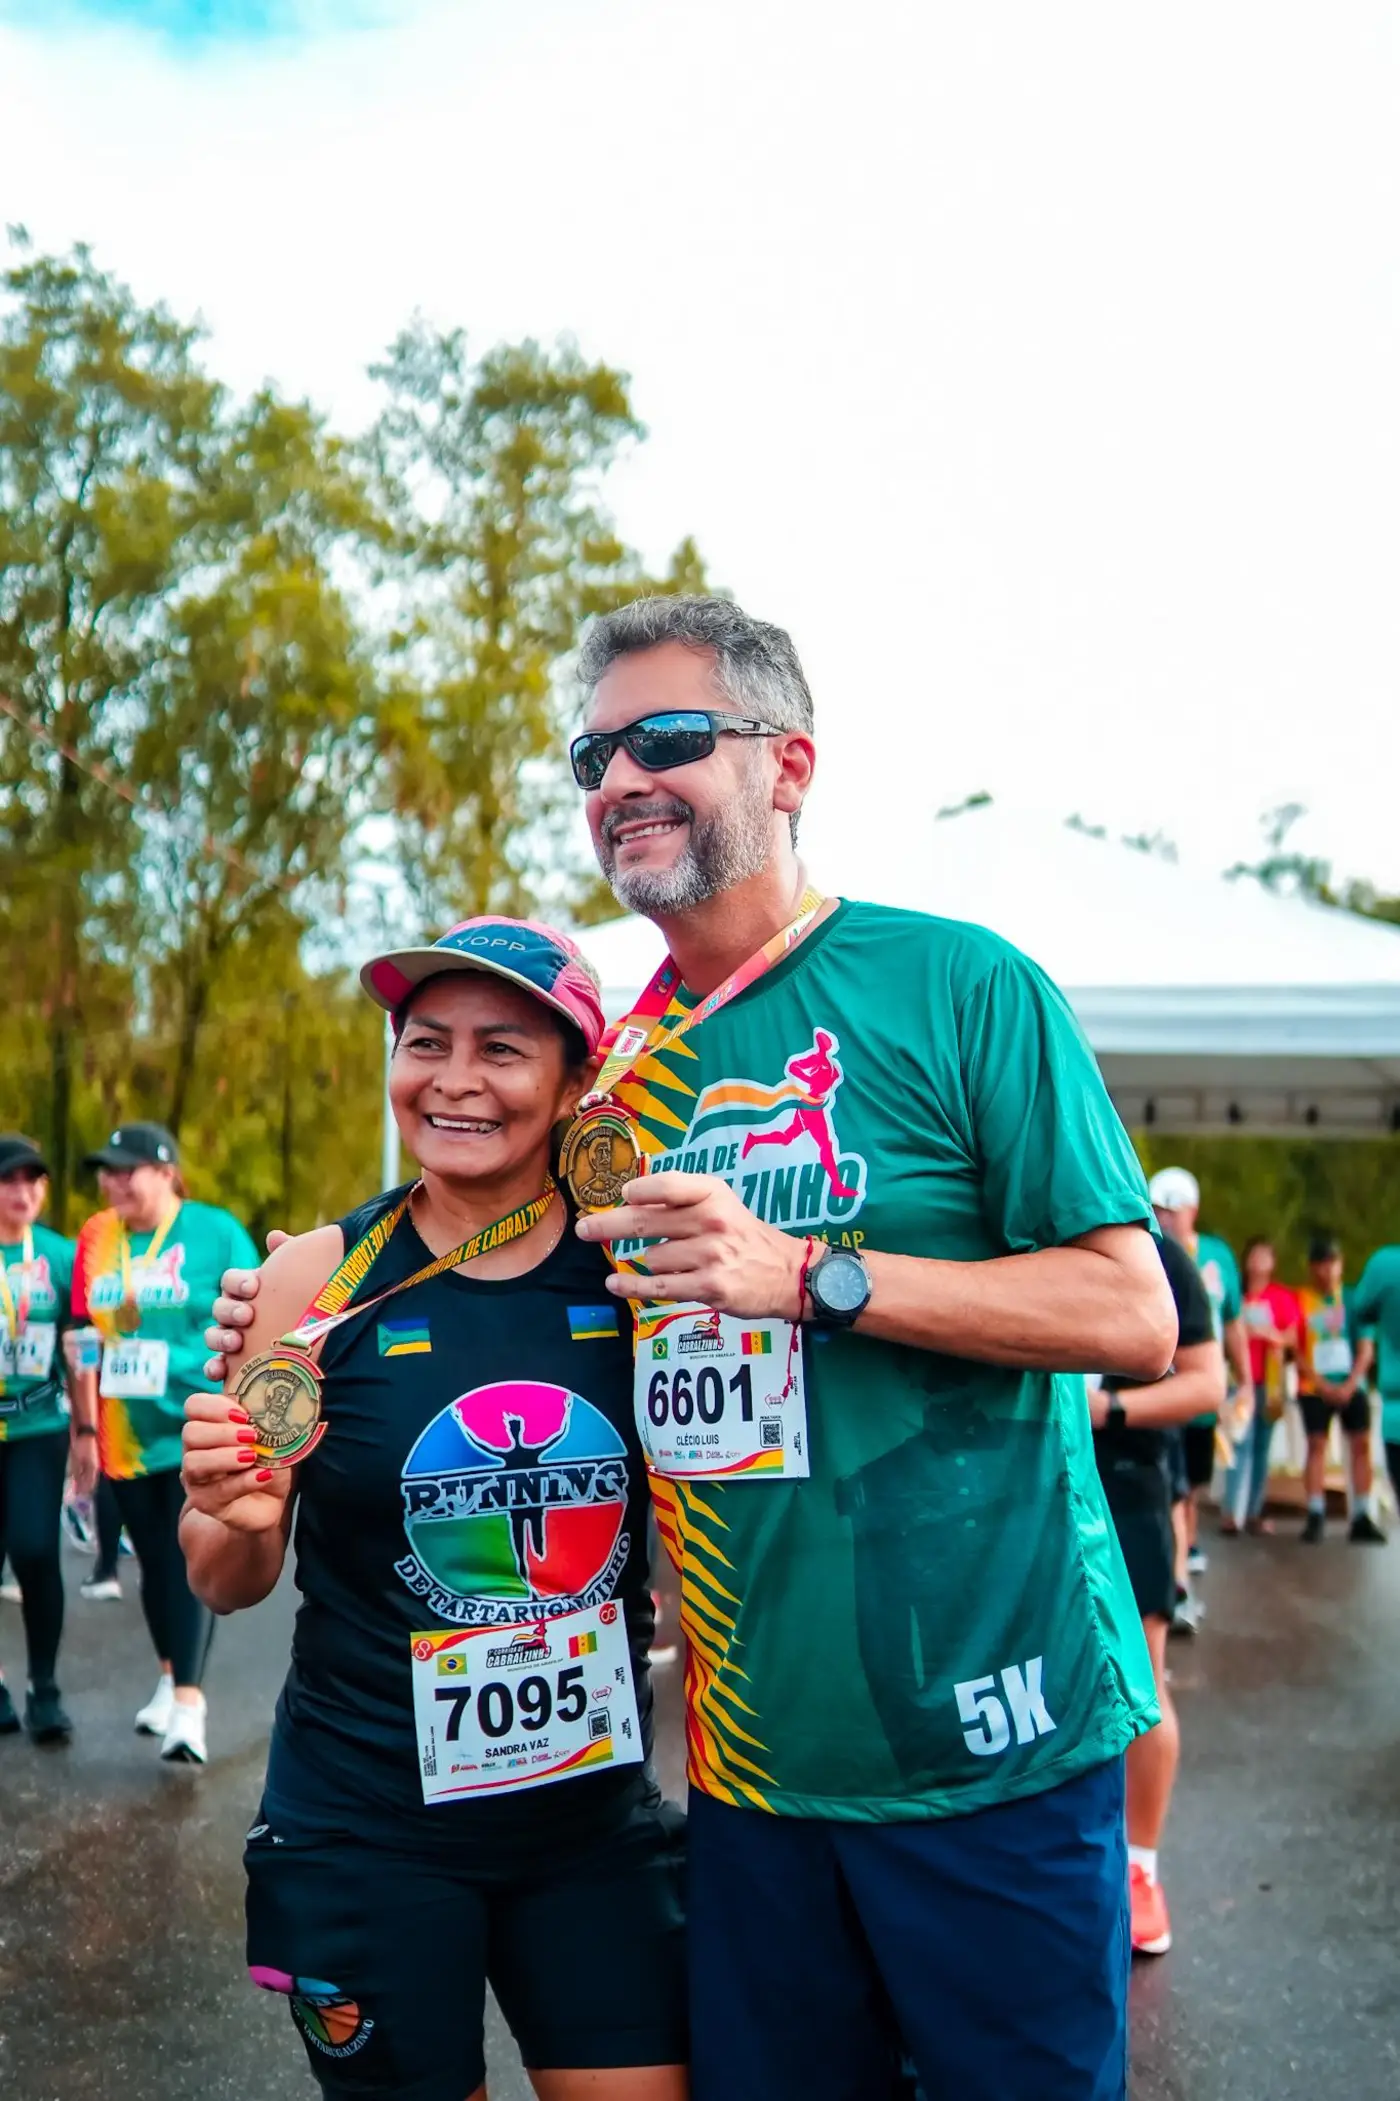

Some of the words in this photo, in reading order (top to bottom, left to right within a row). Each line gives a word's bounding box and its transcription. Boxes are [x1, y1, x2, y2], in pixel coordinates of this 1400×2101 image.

[456, 935, 527, 952] YOPP
[650, 1148, 709, 1175] RRIDA
[712, 1142, 739, 1173] DE
[463, 1235, 482, 1261] DE
[648, 1363, 753, 1427] 6601
[676, 1432, 701, 1446] CLÉCIO
[701, 1434, 720, 1446] LUIS
[401, 1462, 629, 1519] RUNNING
[395, 1555, 432, 1594] DE
[487, 1646, 551, 1668] CABRALZINHO
[434, 1664, 588, 1742] 7095
[953, 1655, 1057, 1756] 5K
[485, 1741, 529, 1759] SANDRA
[529, 1737, 550, 1751] VAZ
